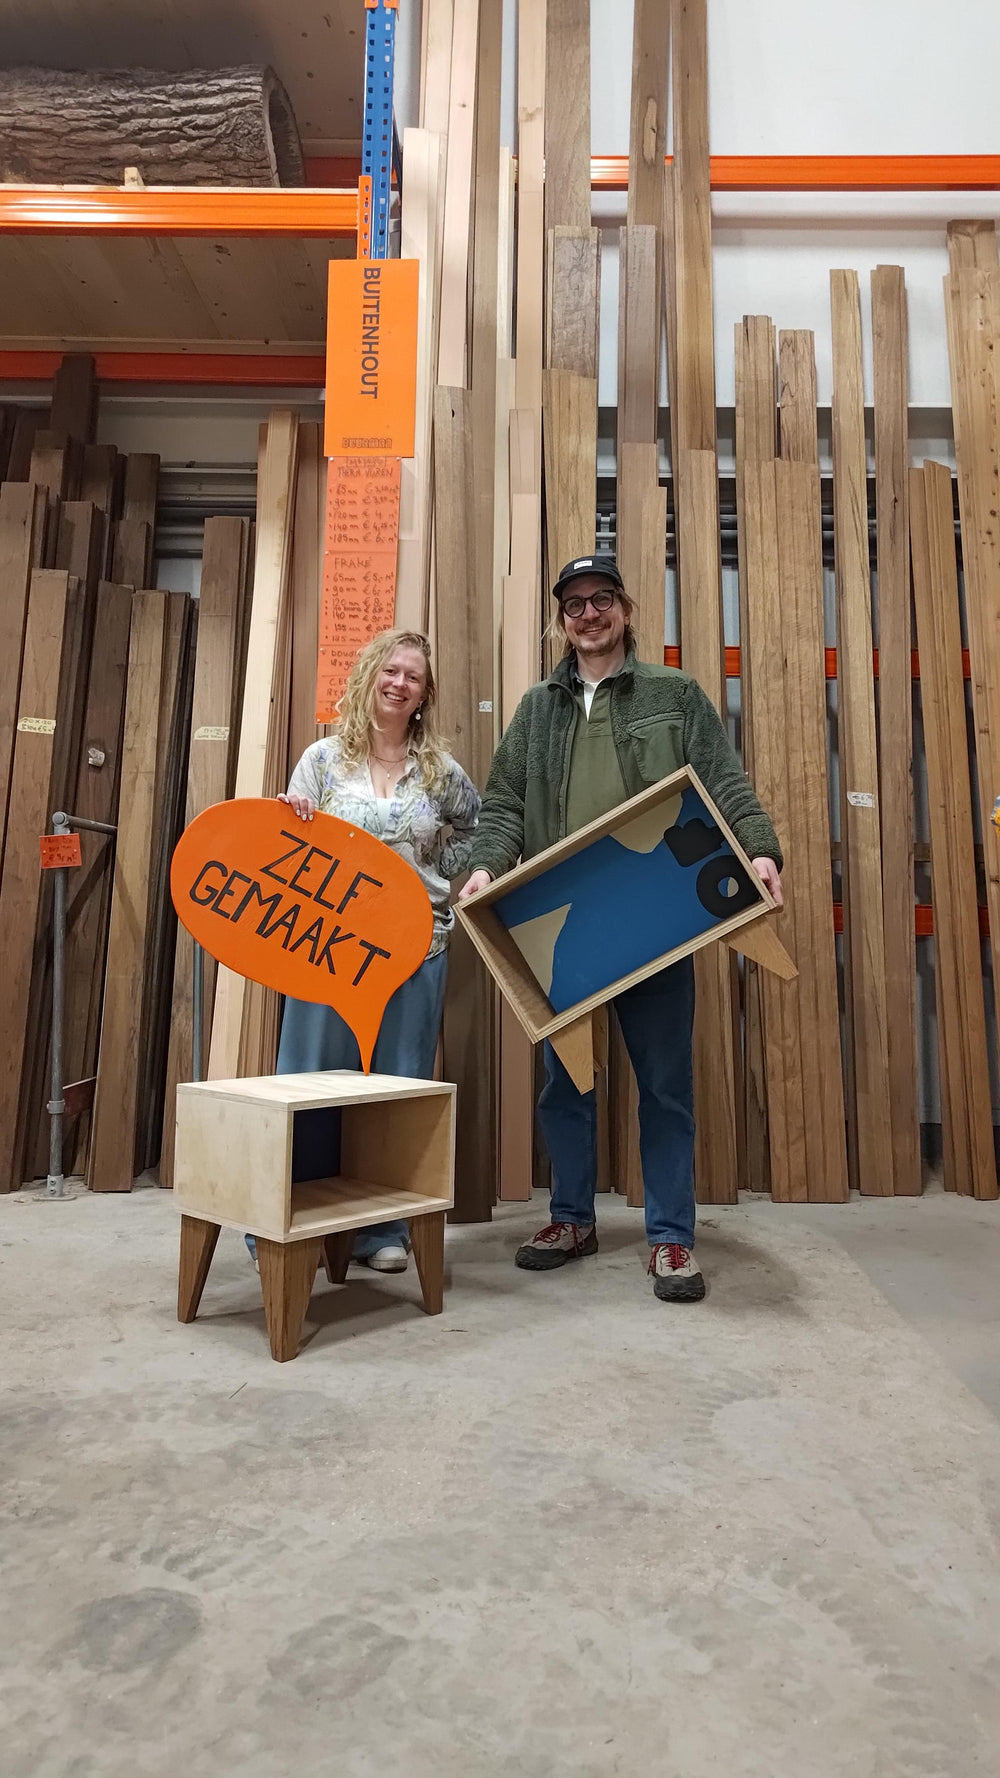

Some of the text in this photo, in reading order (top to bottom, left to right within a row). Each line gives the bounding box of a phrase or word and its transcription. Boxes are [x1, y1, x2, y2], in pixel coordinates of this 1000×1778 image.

[360, 267, 381, 399] BUITENHOUT
[189, 860, 392, 987] GEMAAKT
[259, 829, 384, 915] ZELF
